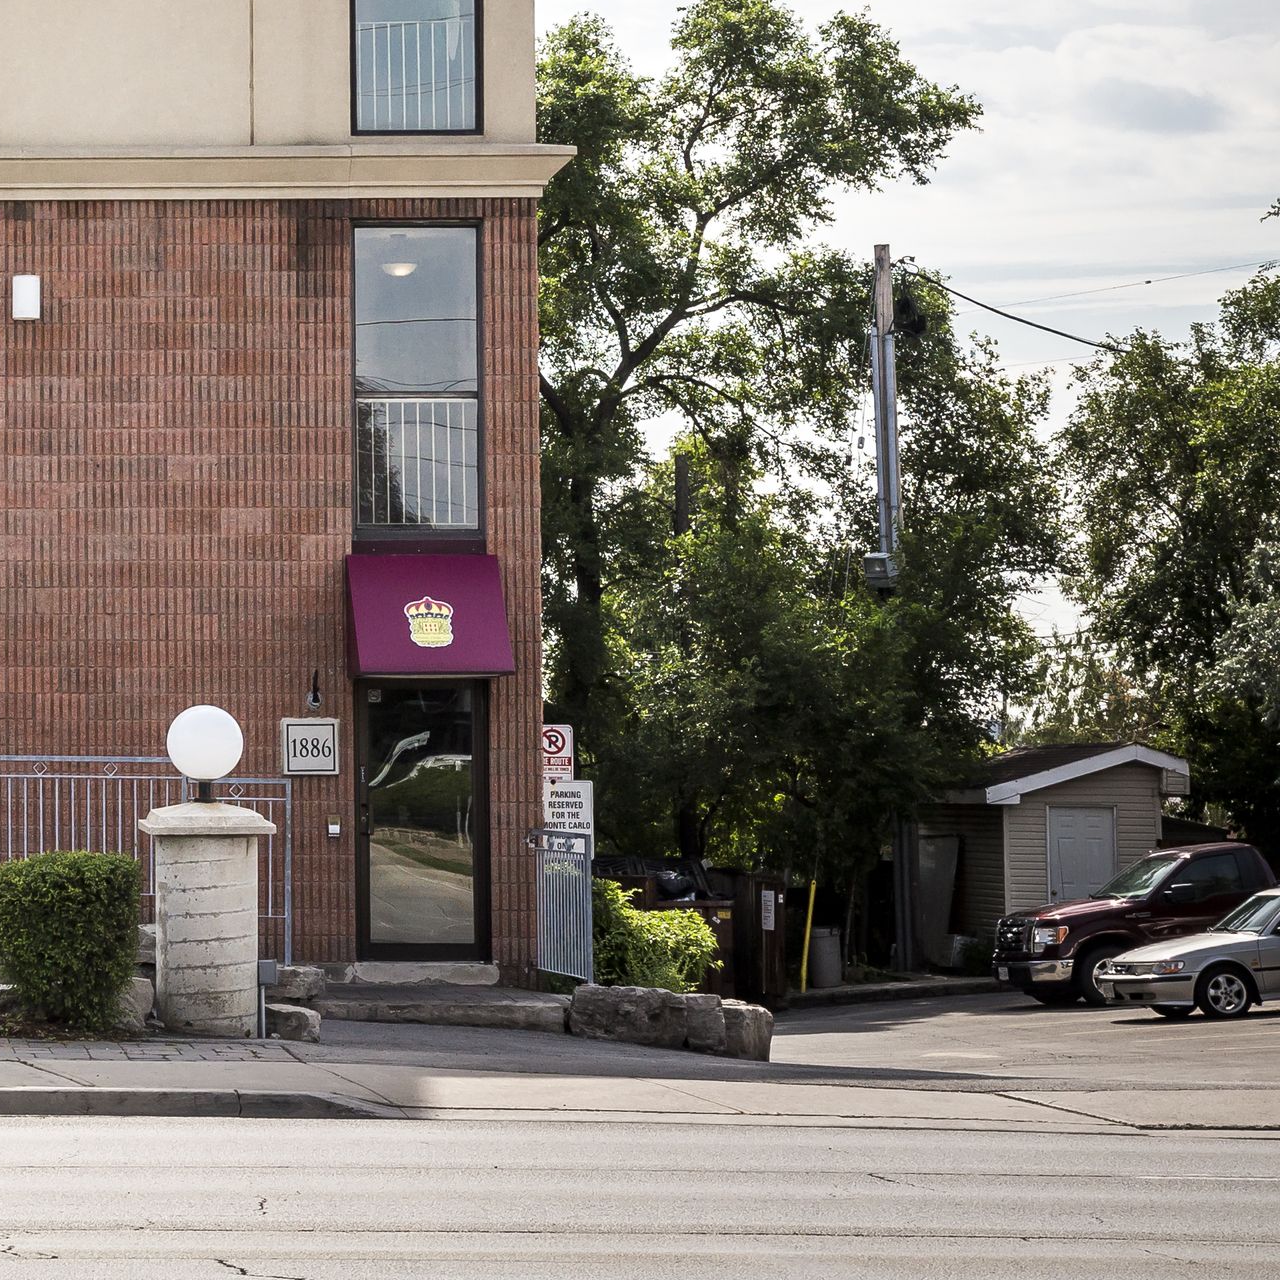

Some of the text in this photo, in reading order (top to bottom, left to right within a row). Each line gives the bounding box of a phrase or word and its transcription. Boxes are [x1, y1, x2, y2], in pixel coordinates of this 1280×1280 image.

[290, 737, 332, 758] 1886
[548, 801, 584, 809] RESERVED
[551, 811, 580, 820] FOR THE
